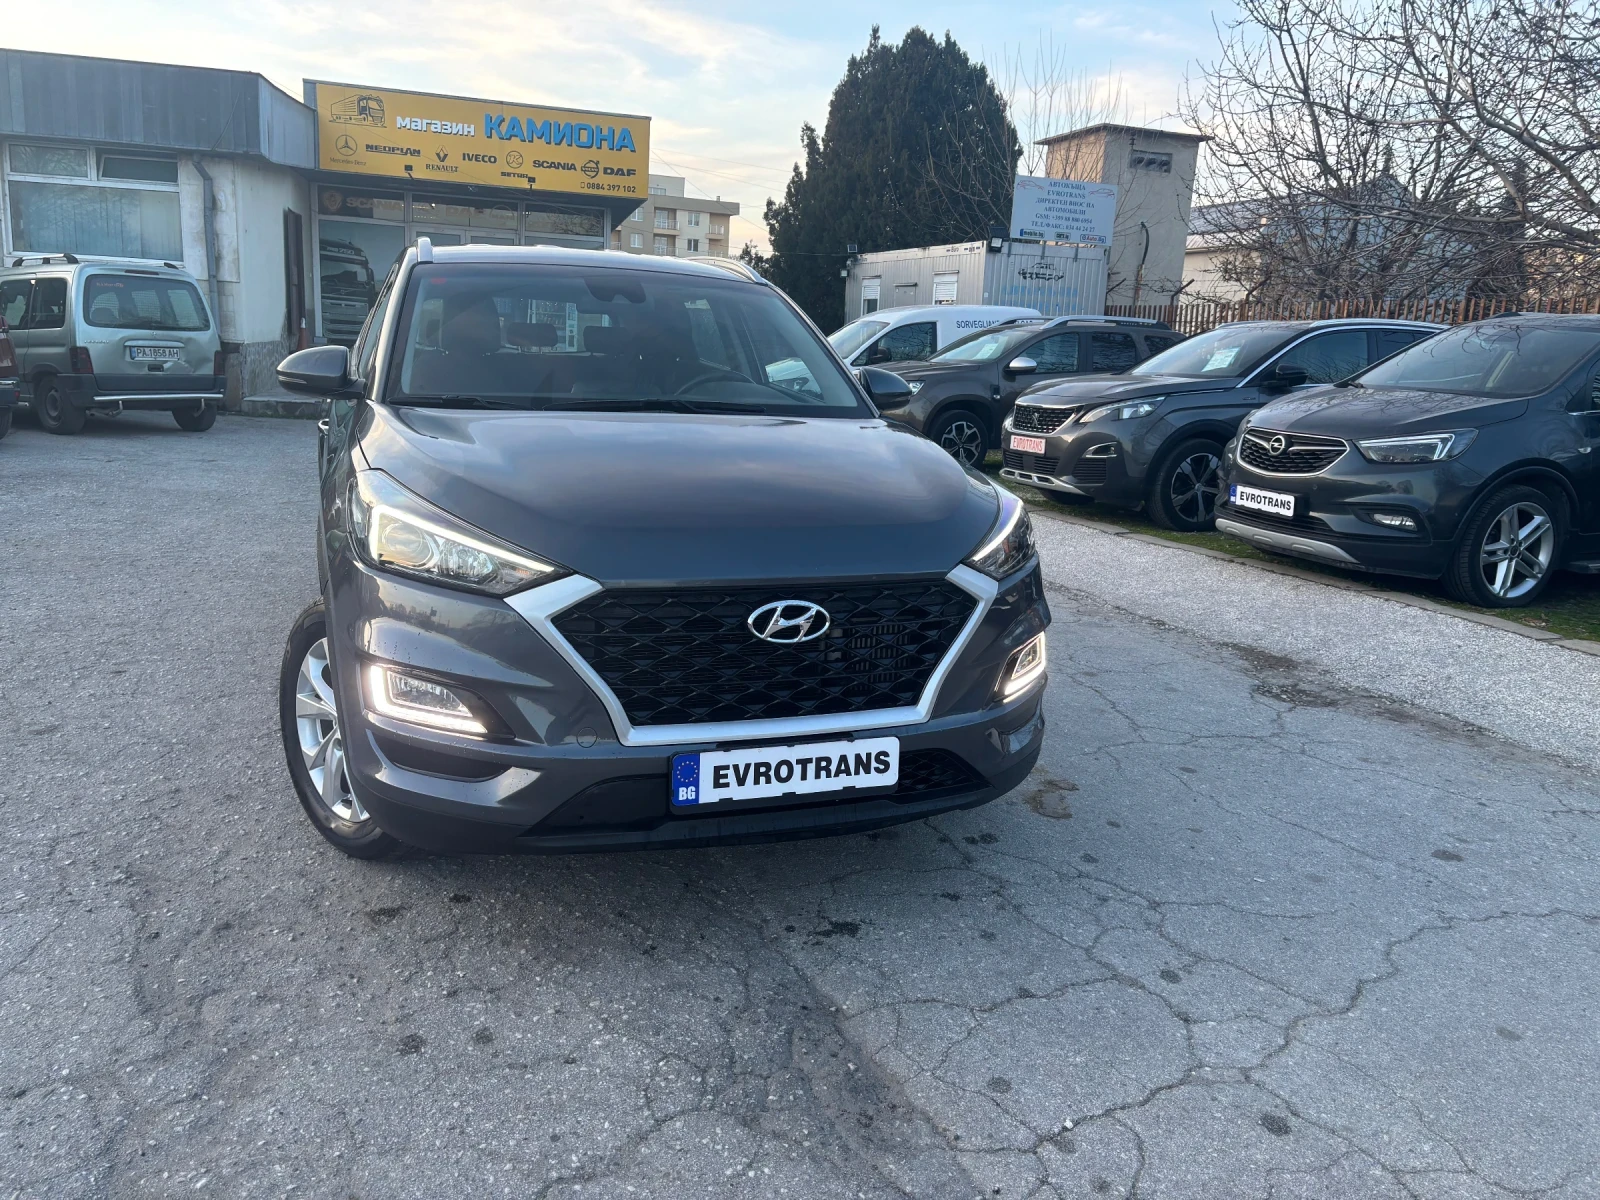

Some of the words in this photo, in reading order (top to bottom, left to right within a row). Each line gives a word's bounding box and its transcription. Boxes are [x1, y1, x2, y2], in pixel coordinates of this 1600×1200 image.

[396, 115, 475, 137] магазин
[483, 113, 637, 153] КАМИОНА
[365, 143, 421, 156] NEOPLAN
[462, 152, 497, 164] IVECO
[425, 163, 459, 173] RENAULT
[532, 159, 577, 171] SCANIA
[602, 166, 637, 177] DAF
[586, 182, 605, 191] 0884
[607, 183, 621, 192] 397
[622, 185, 637, 193] 102
[1047, 189, 1086, 199] EVROTRANS
[1013, 436, 1043, 452] EVROTRANS
[1240, 491, 1292, 511] EVROTRANS
[713, 750, 891, 790] EVROTRANS
[678, 786, 696, 801] BG
